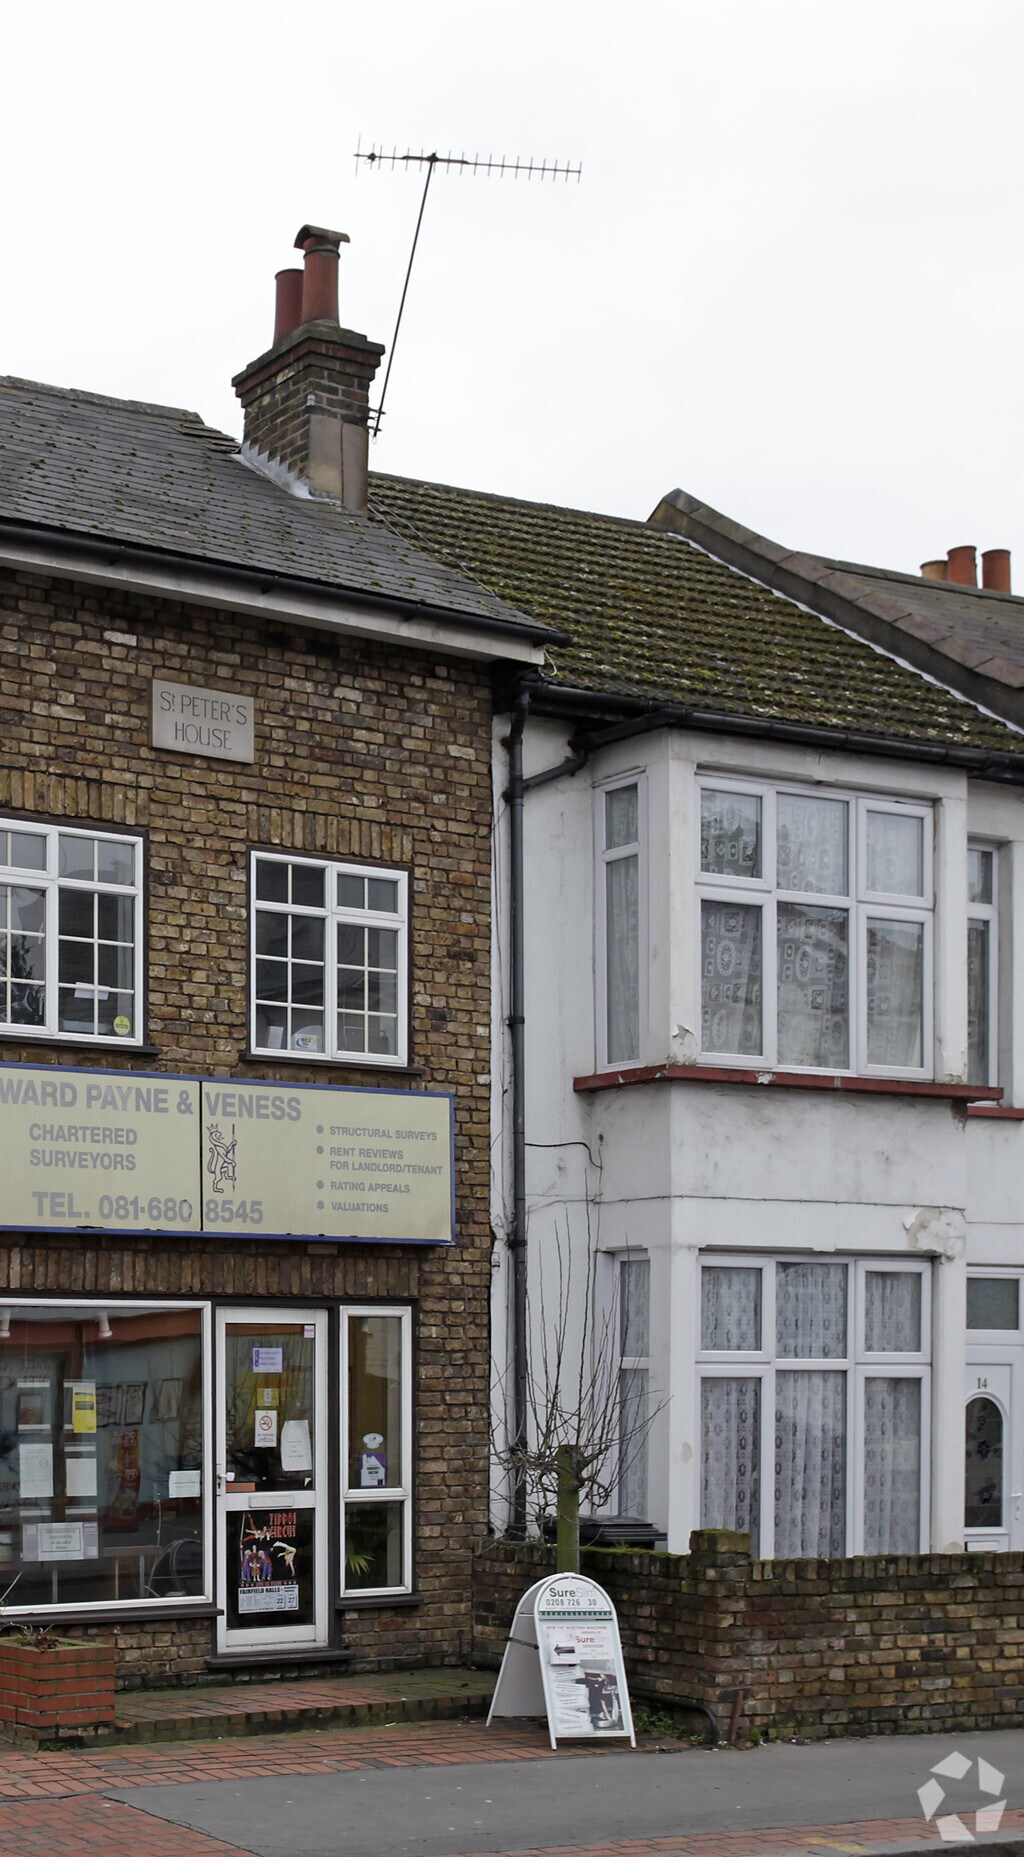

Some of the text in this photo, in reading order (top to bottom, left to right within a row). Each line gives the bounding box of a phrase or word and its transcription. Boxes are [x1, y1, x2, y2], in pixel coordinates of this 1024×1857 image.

[181, 694, 248, 725] PETER'S
[174, 721, 232, 751] HOUSE
[86, 1084, 169, 1114] PAYNE
[176, 1089, 194, 1115] &
[204, 1091, 302, 1121] VENESS
[29, 1123, 138, 1145] CHARTERED
[329, 1125, 438, 1141] STRUCTURAL SURVEYS
[29, 1148, 136, 1171] SURVEYORS
[329, 1146, 404, 1160] RENT REVIEWS
[329, 1160, 443, 1175] FOR LANDLORD/TENANT
[330, 1181, 411, 1194] RATING APPEALS
[32, 1191, 90, 1219] TEL.
[205, 1199, 264, 1224] 8545
[331, 1201, 389, 1213] VALUATIONS
[976, 1377, 988, 1390] 14
